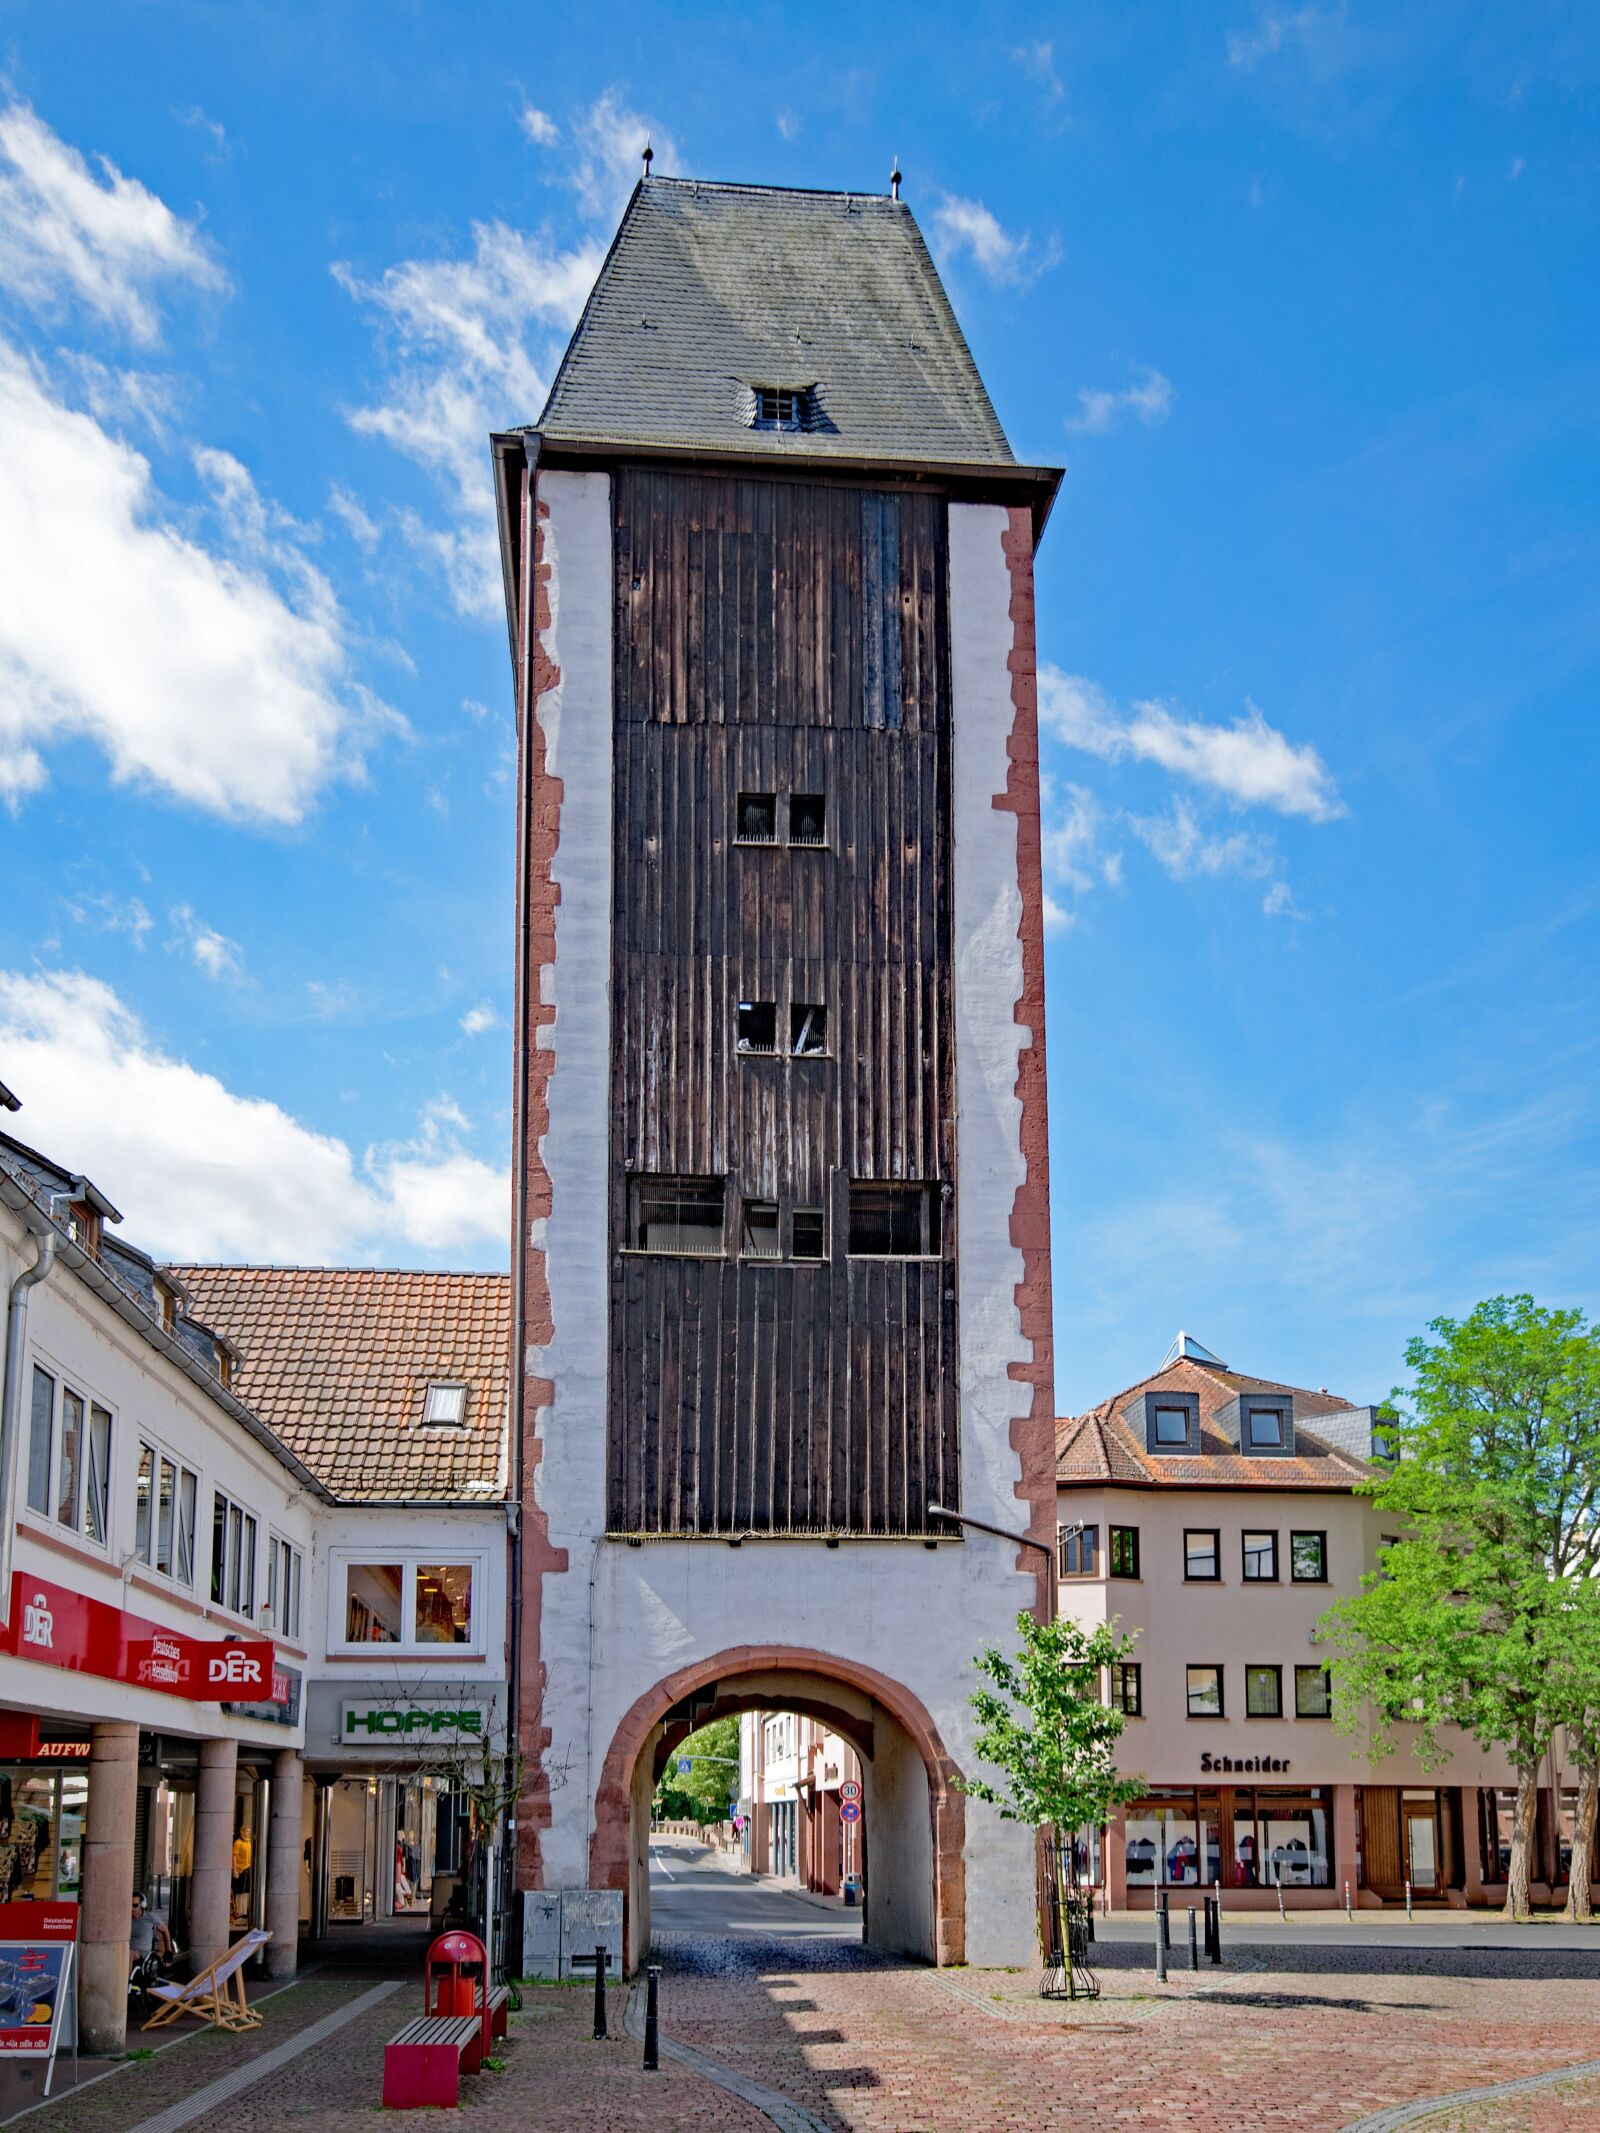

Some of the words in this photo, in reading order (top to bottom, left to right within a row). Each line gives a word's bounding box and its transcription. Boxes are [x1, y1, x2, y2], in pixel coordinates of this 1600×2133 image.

[23, 1604, 54, 1649] DER
[152, 1636, 181, 1660] Deutsches
[151, 1660, 179, 1684] Reisebüro
[208, 1659, 262, 1682] DER
[346, 1711, 482, 1733] HOPPE
[1200, 1752, 1290, 1772] Schneider
[844, 1786, 857, 1796] 30
